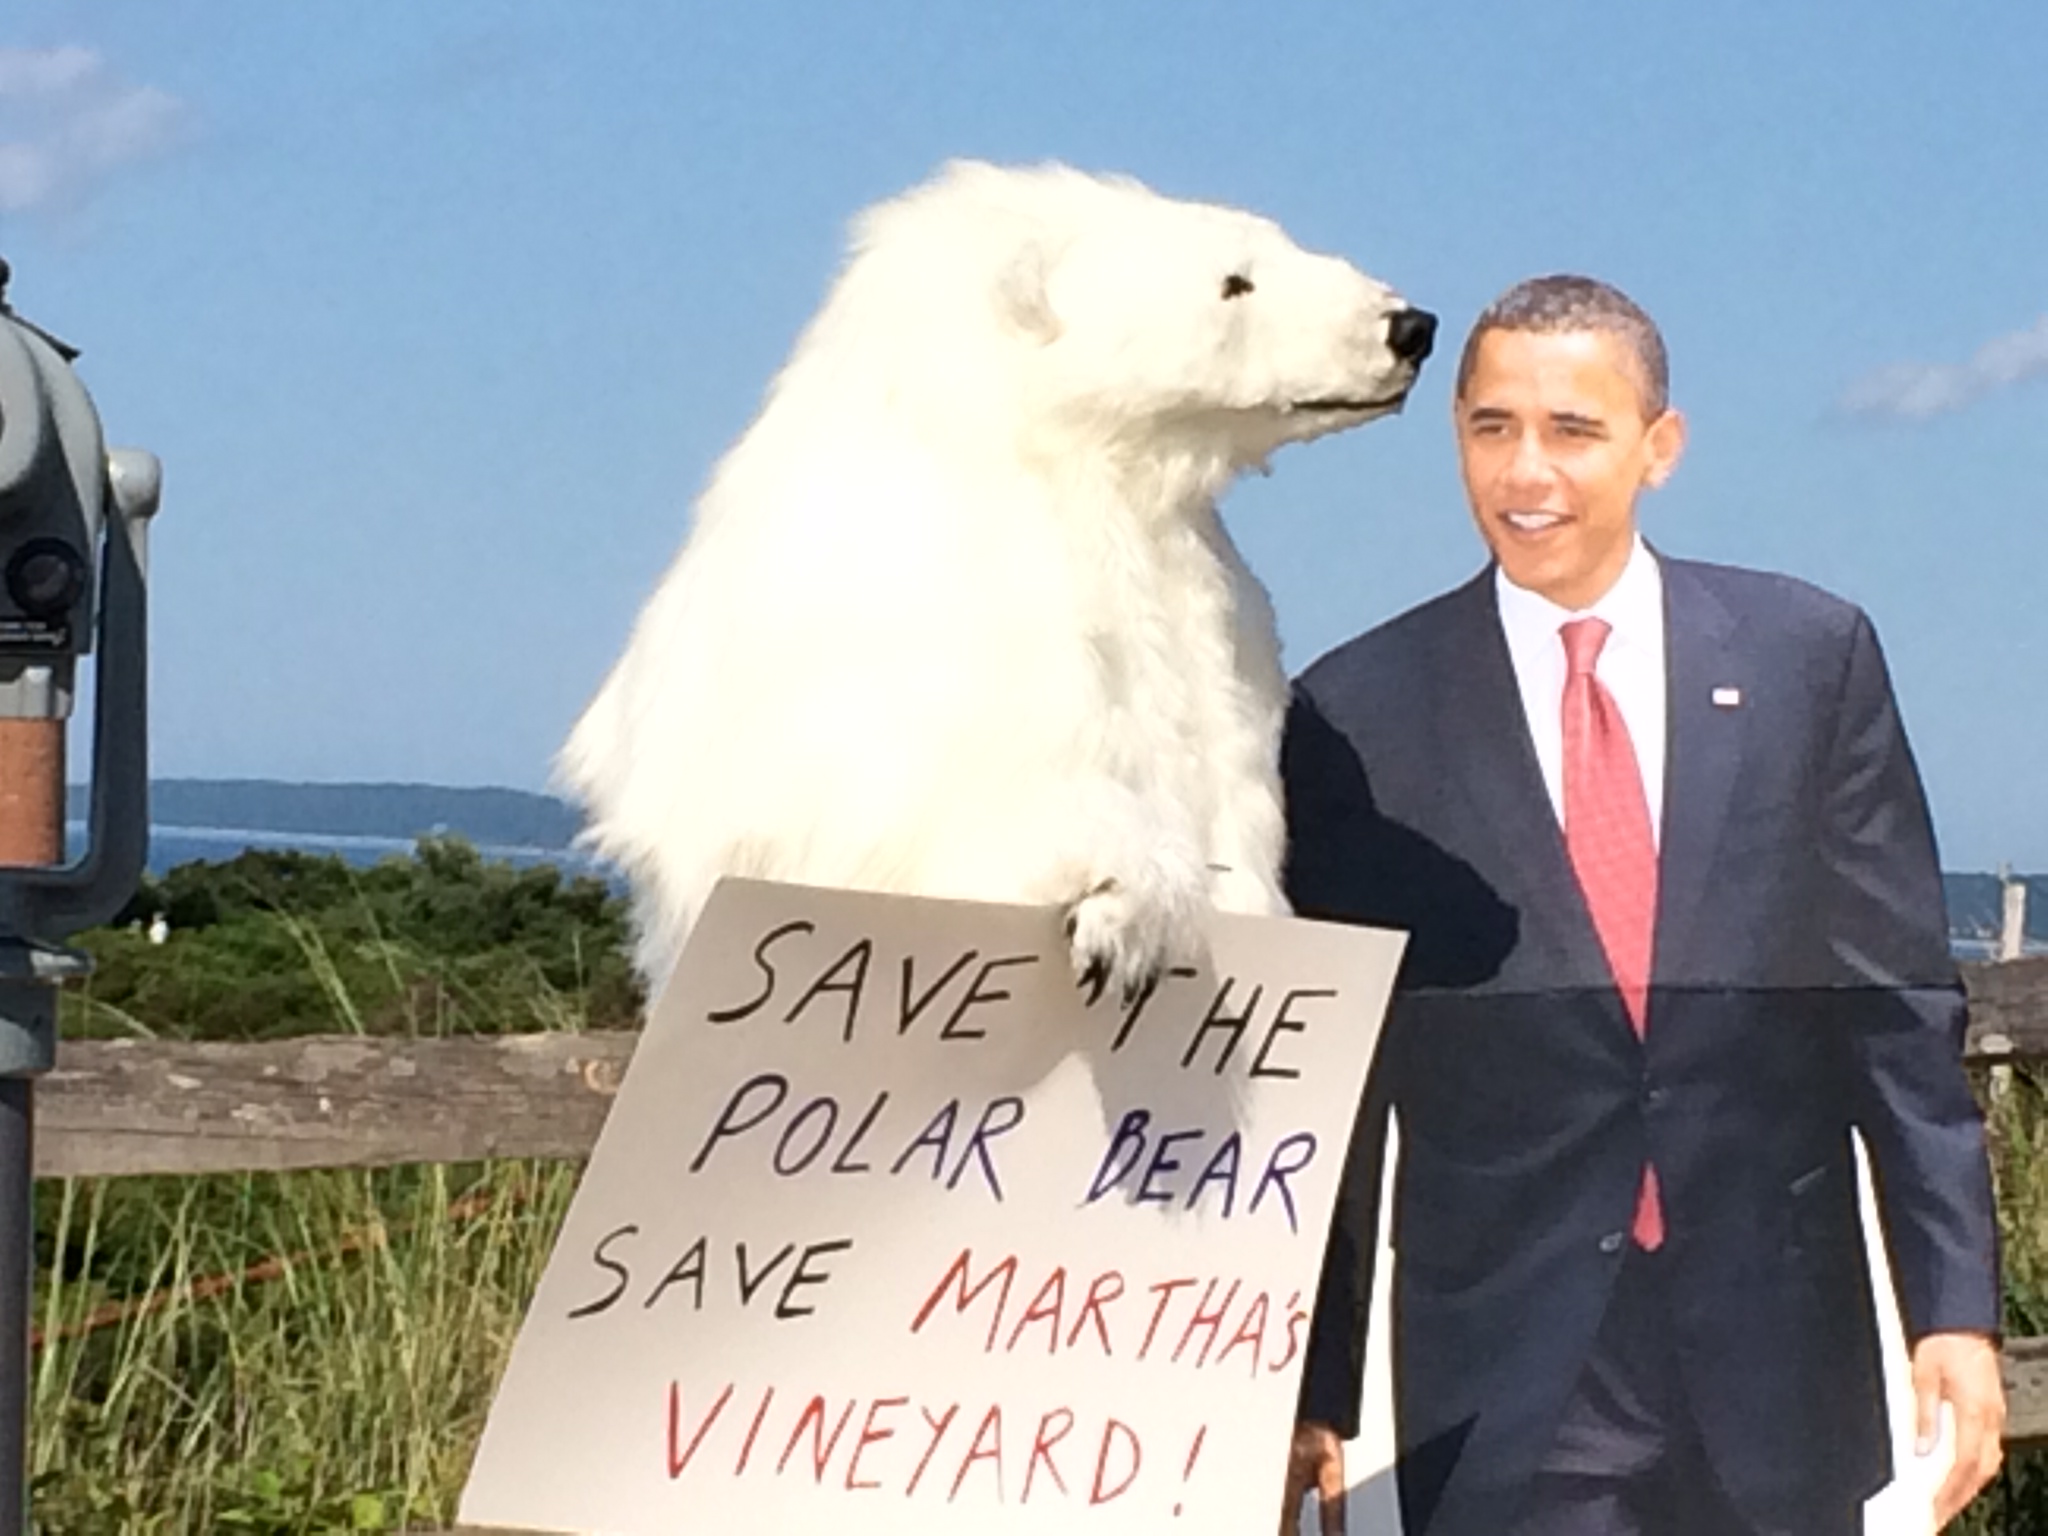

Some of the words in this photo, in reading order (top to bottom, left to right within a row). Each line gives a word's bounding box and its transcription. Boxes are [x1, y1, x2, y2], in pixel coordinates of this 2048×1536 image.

[707, 919, 1039, 1043] SAVE
[1109, 965, 1338, 1080] THE
[689, 1073, 1025, 1202] POLAR
[1087, 1109, 1318, 1235] BEAR
[567, 1225, 853, 1320] SAVE
